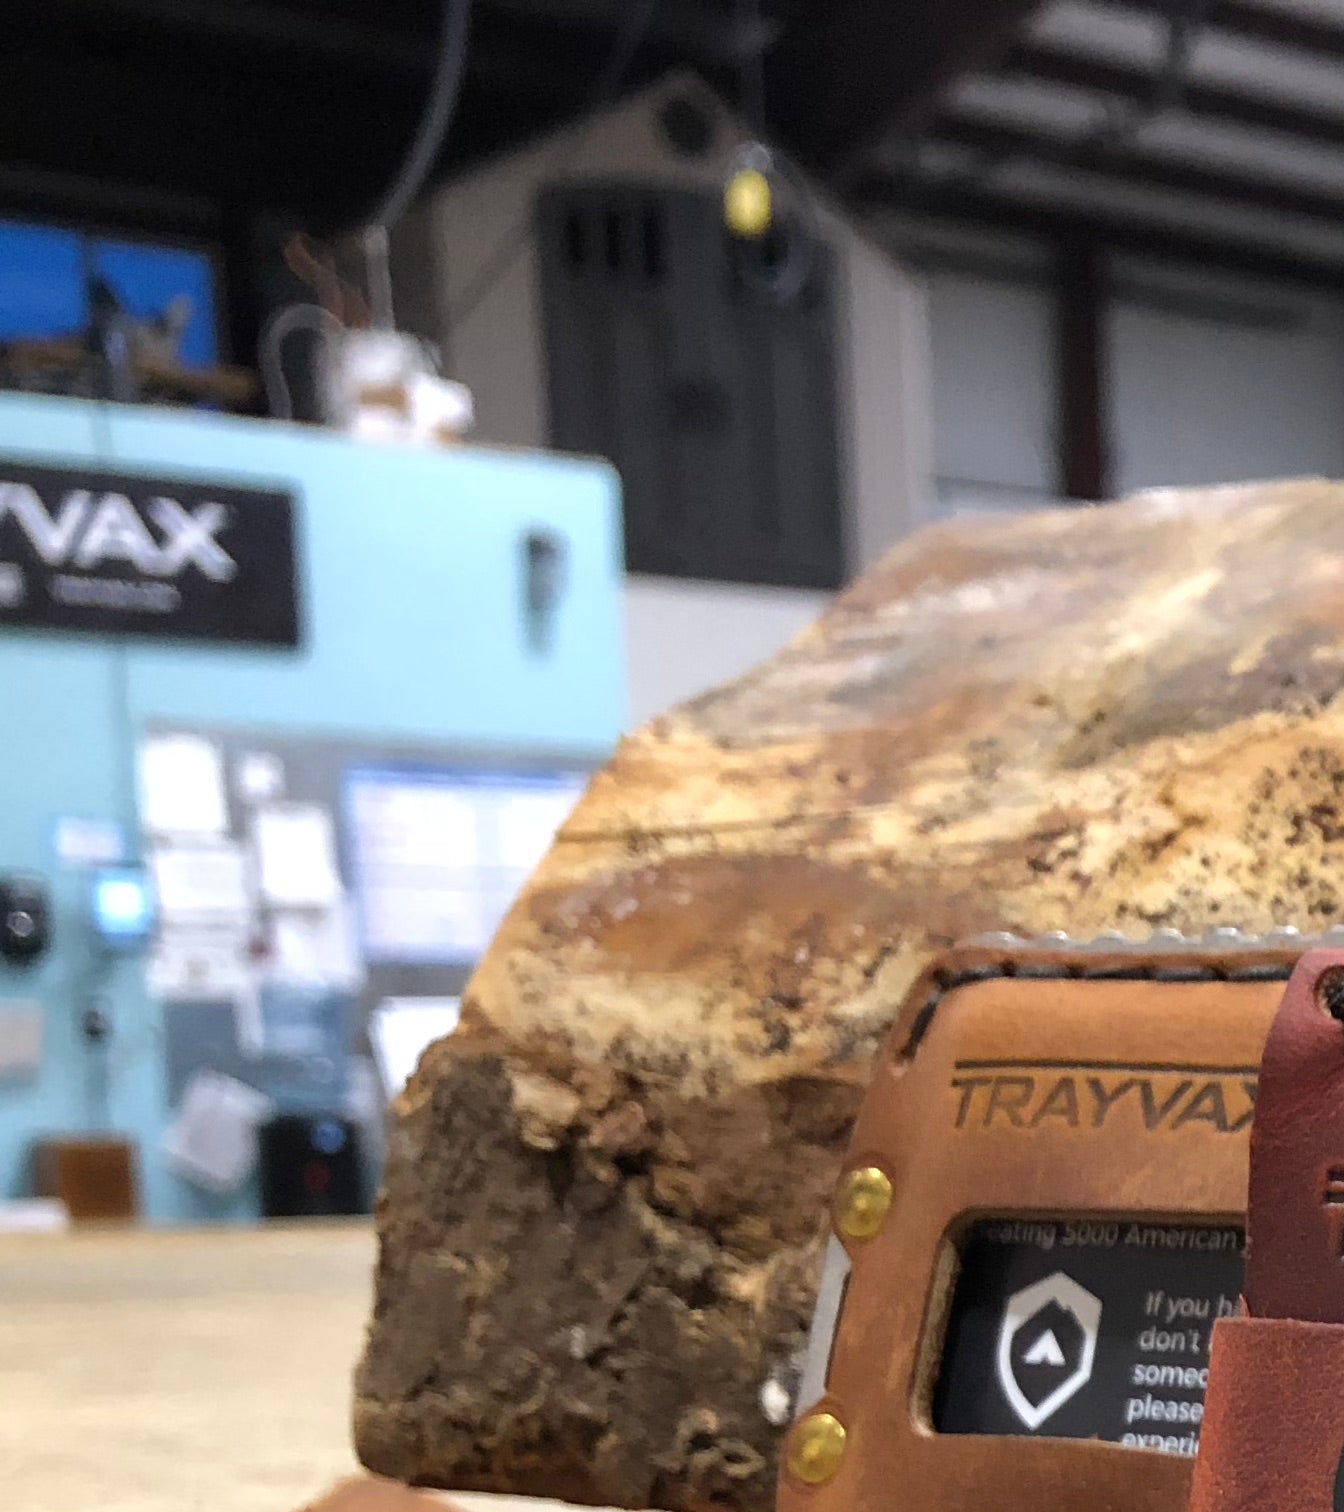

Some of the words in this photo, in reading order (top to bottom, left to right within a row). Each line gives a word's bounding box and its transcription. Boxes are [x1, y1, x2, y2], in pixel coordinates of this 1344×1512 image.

[1062, 1223, 1120, 1248] 5000
[1124, 1223, 1238, 1250] American
[1165, 1296, 1209, 1324] you
[1138, 1325, 1200, 1353] don't
[1126, 1393, 1204, 1426] please
